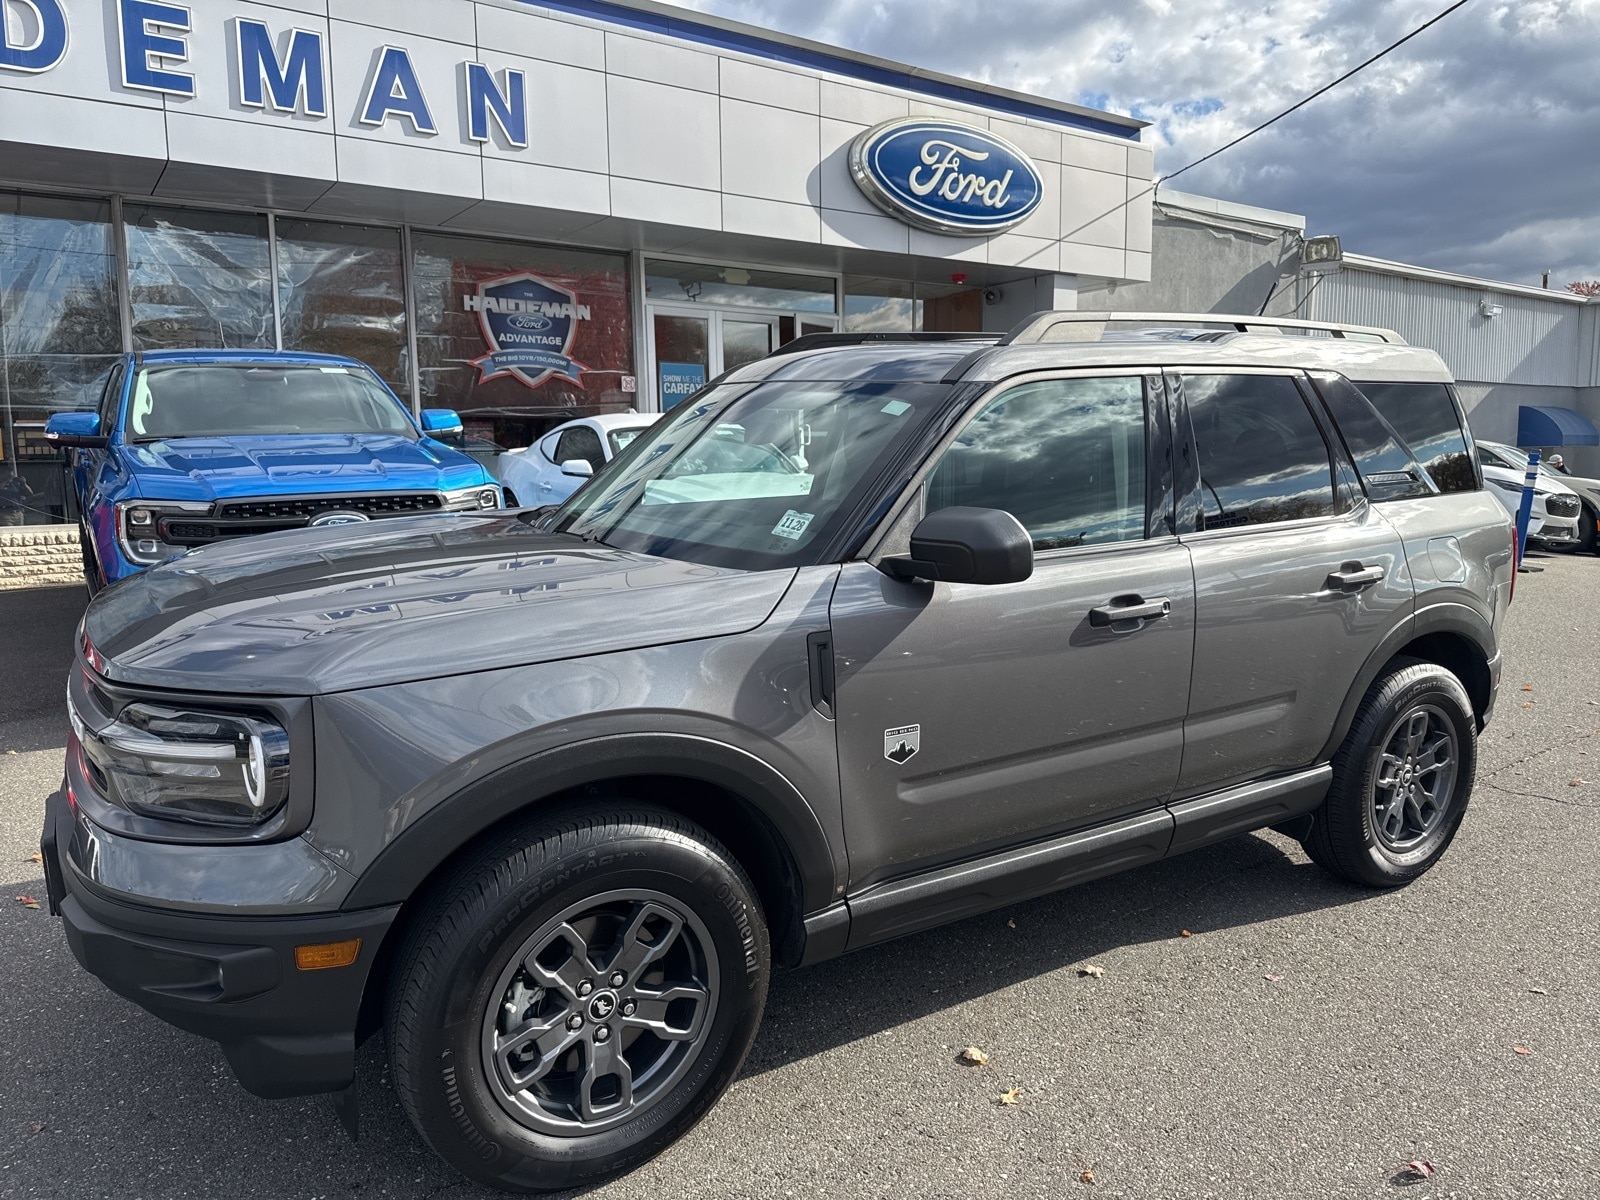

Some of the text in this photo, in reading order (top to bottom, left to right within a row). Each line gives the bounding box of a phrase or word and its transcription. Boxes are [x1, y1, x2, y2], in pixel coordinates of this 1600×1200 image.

[908, 139, 1014, 209] Ford
[463, 294, 591, 321] HALDEMAN
[515, 315, 544, 329] Ford
[498, 332, 563, 346] ADVANTAGE
[494, 355, 507, 363] THE
[663, 374, 703, 384] SHOW ME THE
[781, 517, 806, 531] 11 28
[712, 879, 761, 975] Continental
